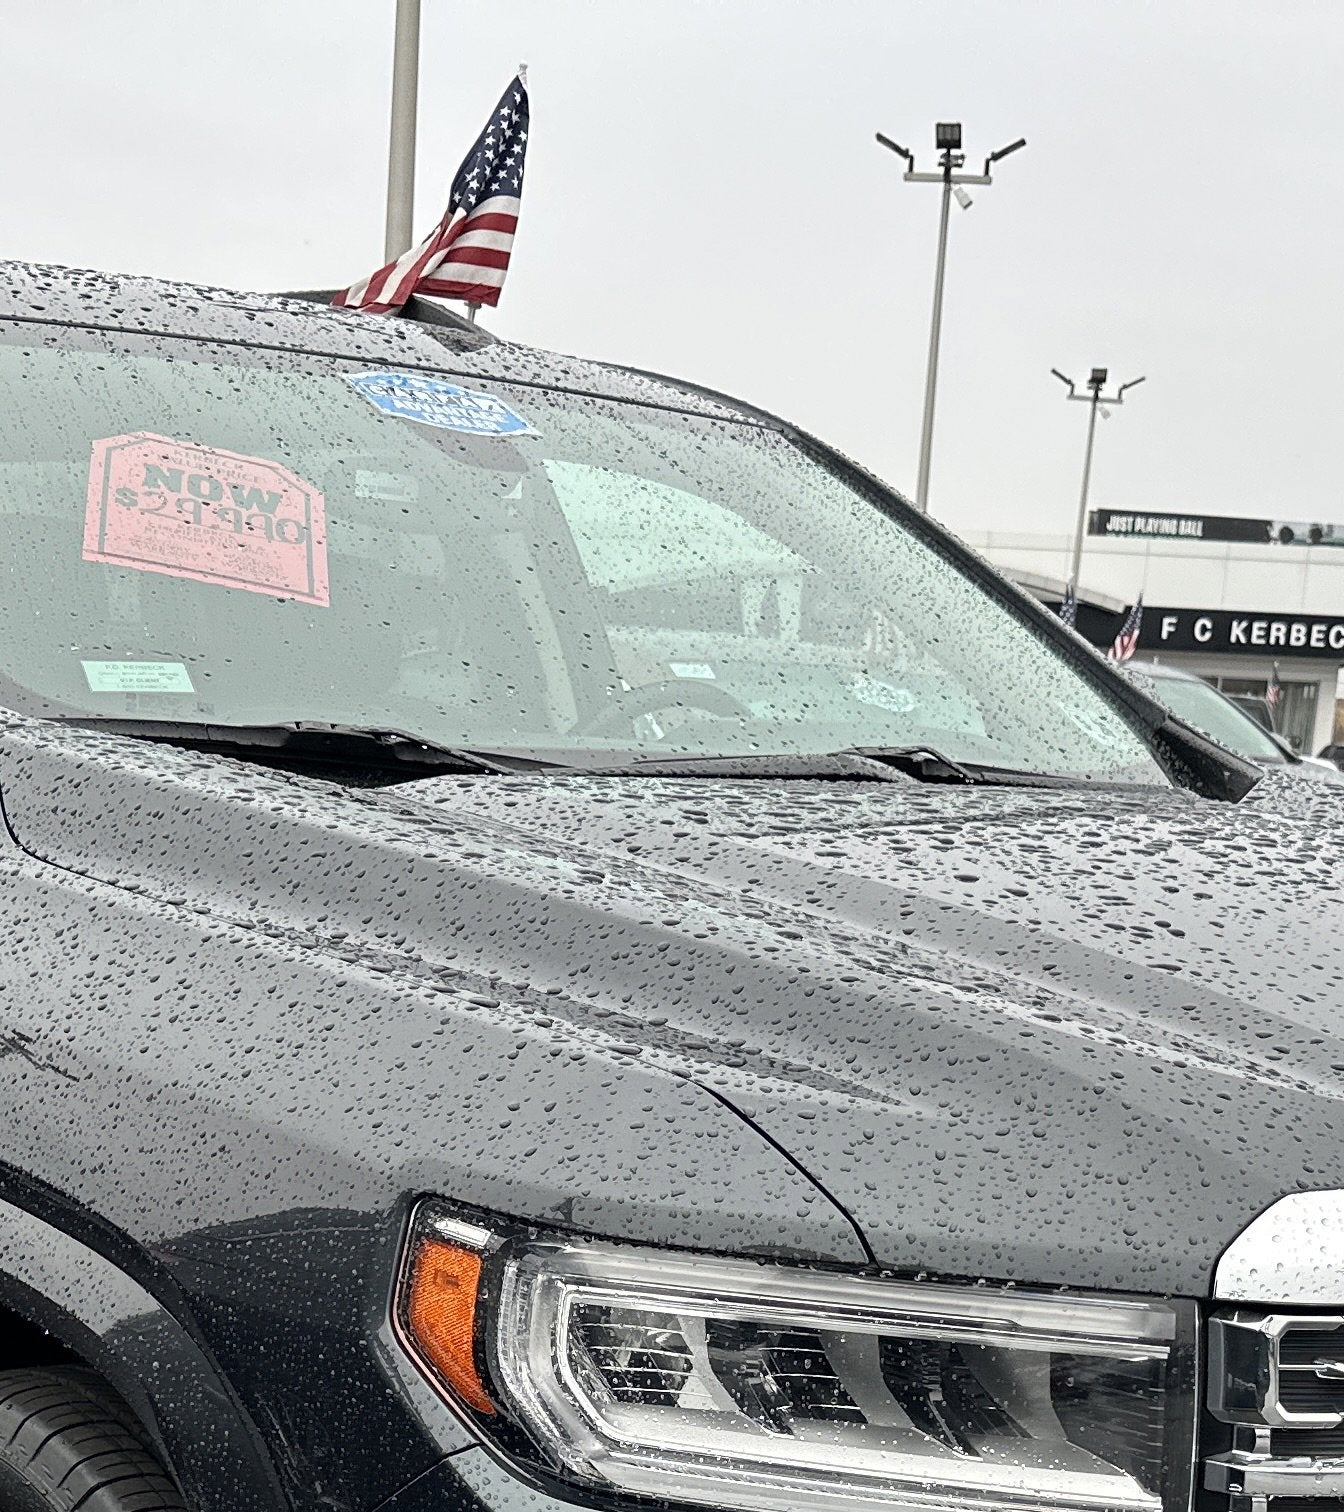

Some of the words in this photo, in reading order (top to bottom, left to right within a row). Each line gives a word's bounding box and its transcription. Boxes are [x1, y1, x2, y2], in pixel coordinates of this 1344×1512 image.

[143, 463, 283, 515] NOW
[1160, 616, 1179, 640] F
[1193, 617, 1213, 642] C
